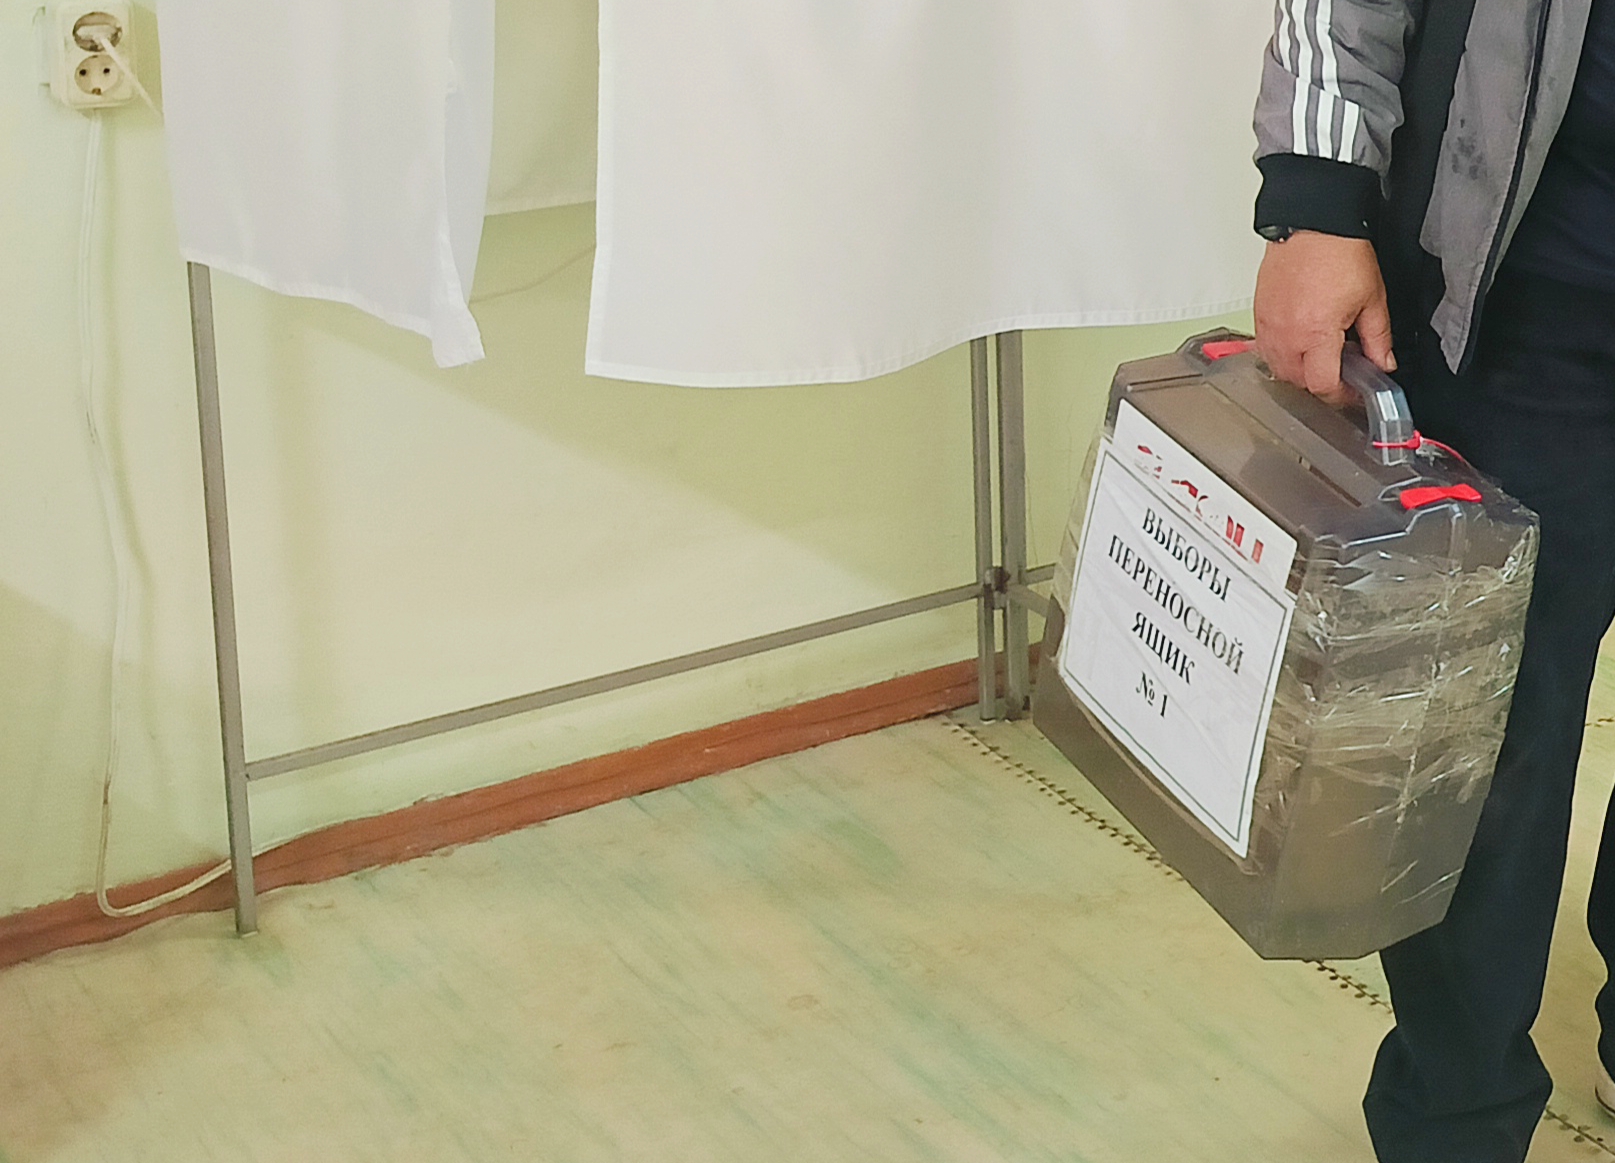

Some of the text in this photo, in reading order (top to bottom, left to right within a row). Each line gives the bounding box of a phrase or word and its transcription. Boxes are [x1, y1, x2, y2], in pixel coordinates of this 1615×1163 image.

[1142, 506, 1232, 603] ВЫБОРЫ
[1108, 534, 1246, 676] ПЕРЕНОСНОЙ
[1132, 611, 1196, 687] ЯЩИК
[1136, 670, 1170, 718] № 1
